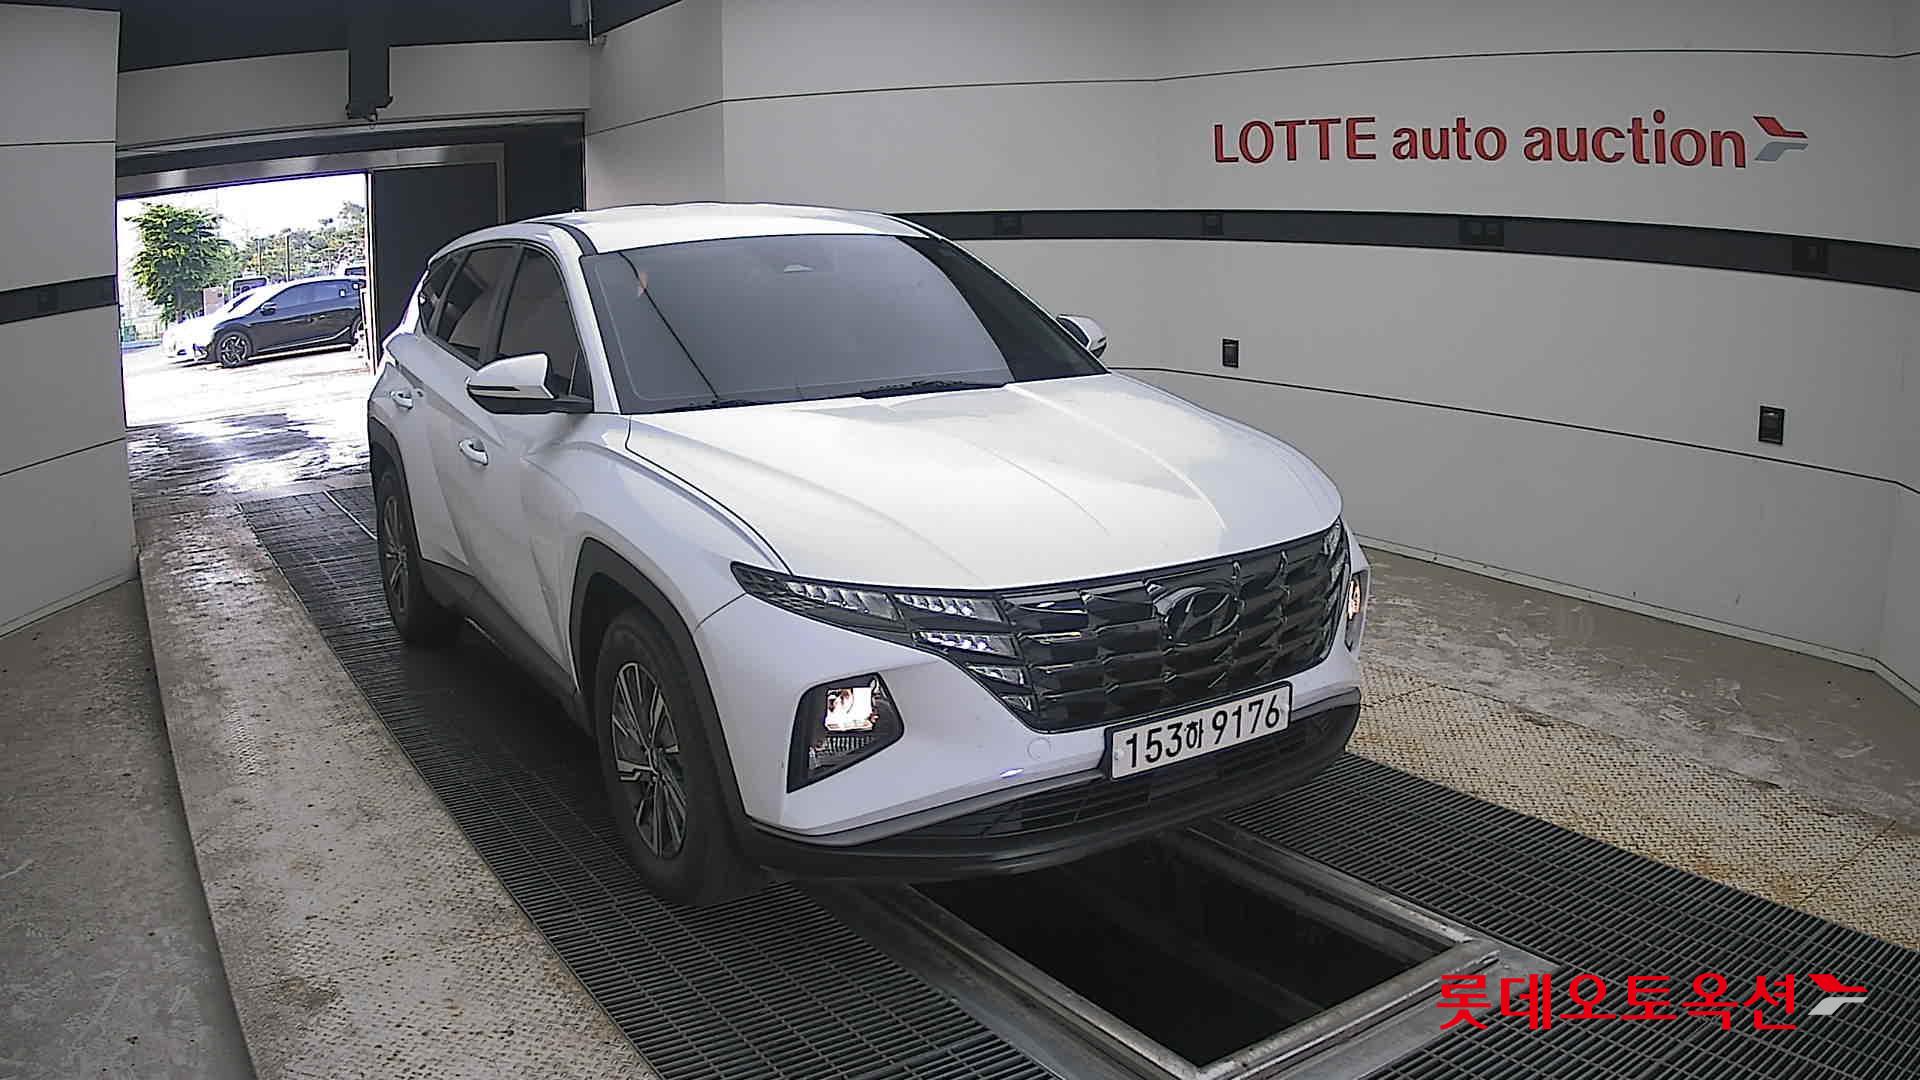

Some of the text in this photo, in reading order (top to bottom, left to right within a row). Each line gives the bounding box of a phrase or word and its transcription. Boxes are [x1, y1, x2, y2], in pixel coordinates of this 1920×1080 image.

[1214, 109, 1747, 168] LOTTE auto auction
[1125, 694, 1281, 769] 153하 9176
